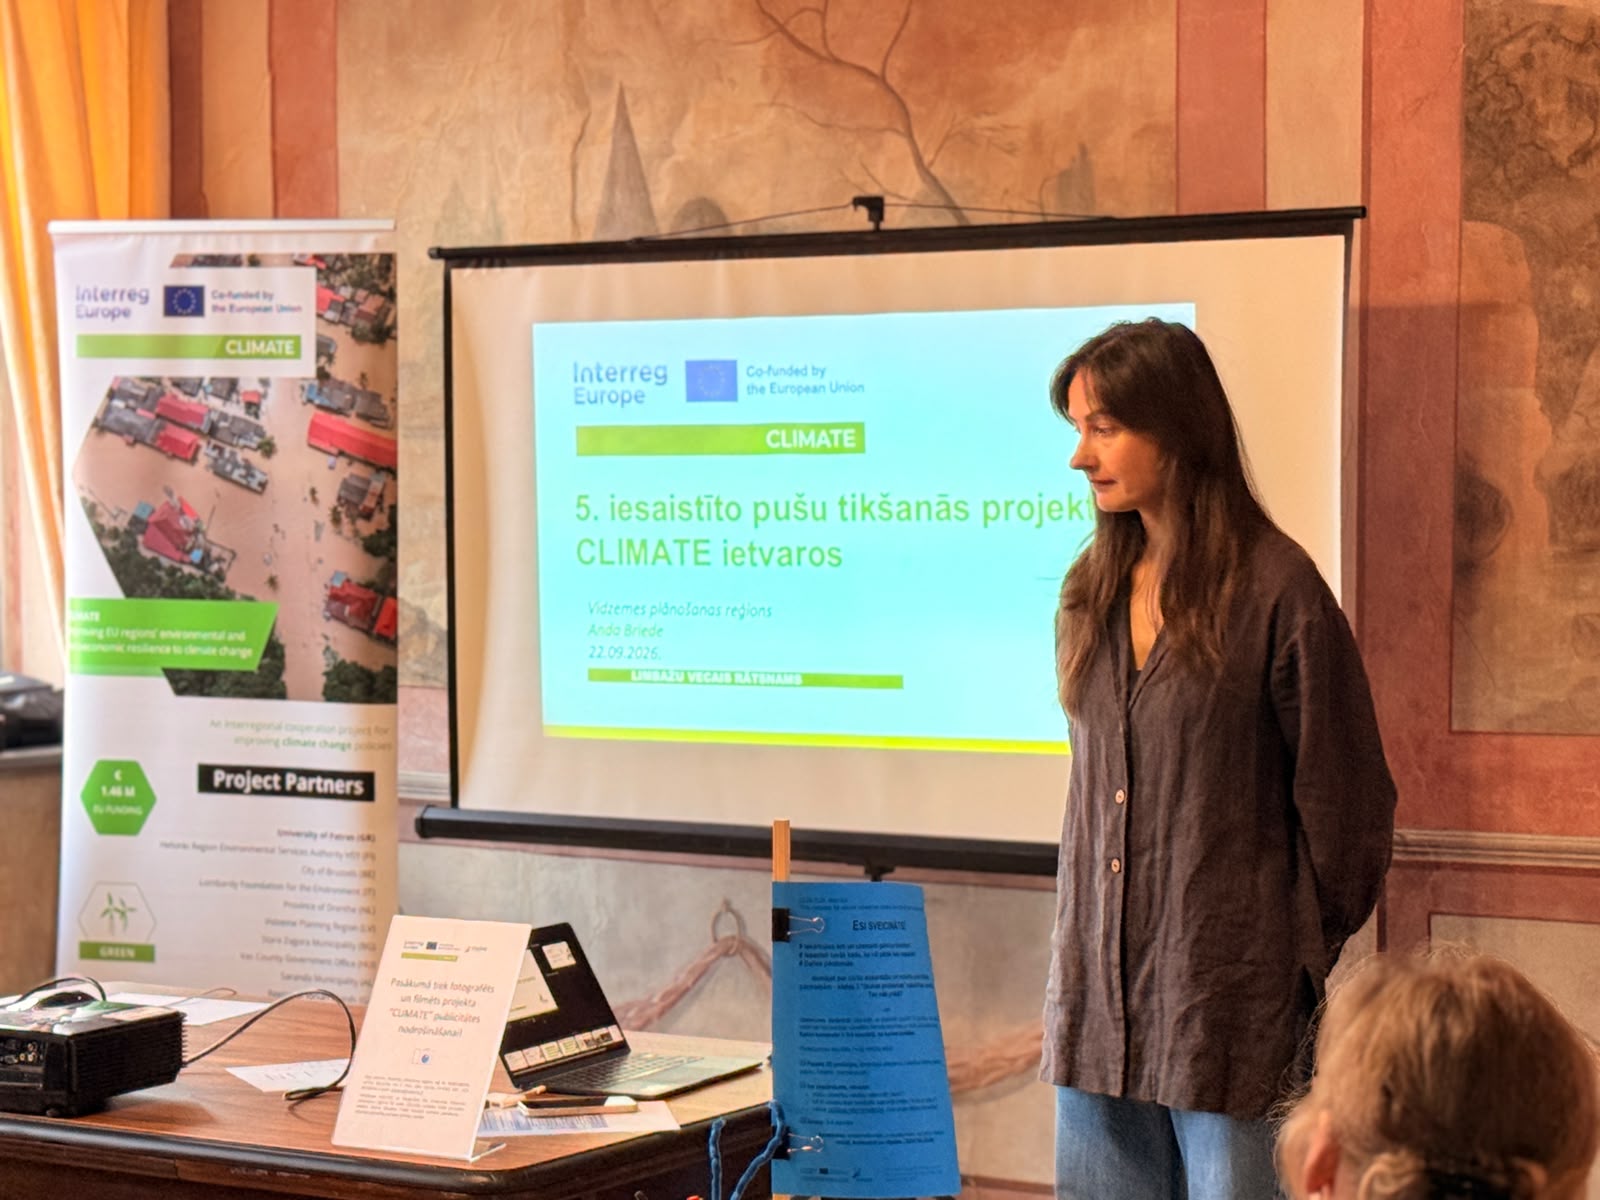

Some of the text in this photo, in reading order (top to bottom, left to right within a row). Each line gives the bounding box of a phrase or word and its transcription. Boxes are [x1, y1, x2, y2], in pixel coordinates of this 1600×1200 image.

[75, 286, 150, 304] Interreg
[211, 289, 274, 302] Co-funded by
[75, 304, 131, 321] Europe
[212, 303, 302, 315] the European Union
[225, 339, 296, 356] CLIMATE
[573, 361, 668, 386] Interreg
[746, 364, 826, 380] Co-funded by
[573, 386, 646, 408] Europe
[747, 382, 866, 396] the European Union
[765, 428, 857, 449] CLIMATE
[575, 494, 600, 522] 5.
[610, 493, 743, 522] iesaistīto
[753, 493, 828, 529] pušu
[838, 493, 971, 522] tikšanās
[575, 538, 844, 567] CLIMATE ietvaros
[587, 601, 647, 616] Vidzemes
[725, 603, 774, 621] reģions
[587, 623, 665, 638] Anda Briede
[213, 768, 364, 796] Project Partners
[99, 945, 136, 959] GREEN
